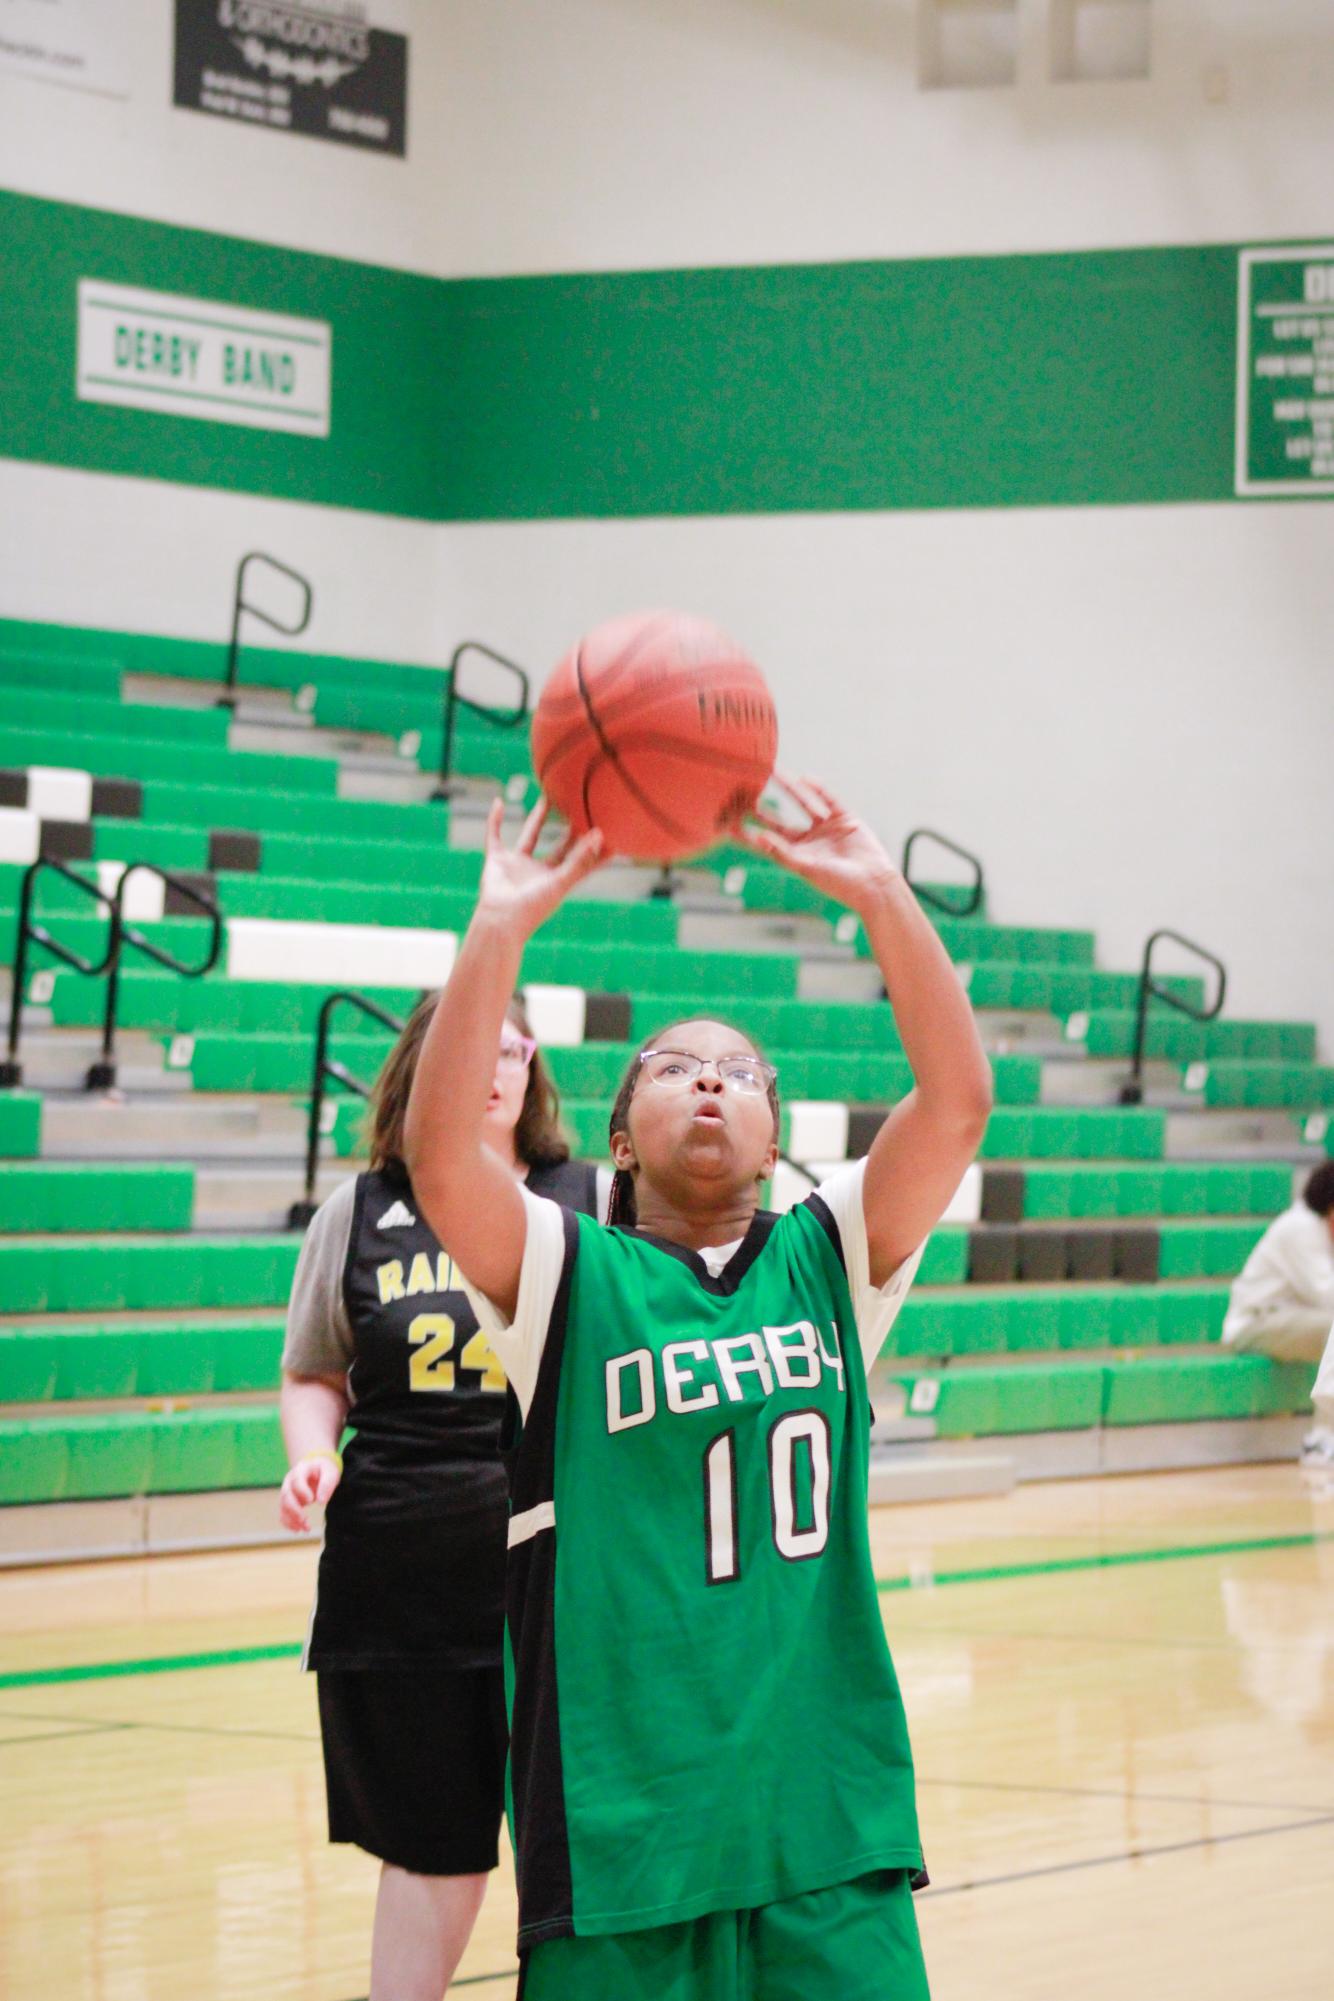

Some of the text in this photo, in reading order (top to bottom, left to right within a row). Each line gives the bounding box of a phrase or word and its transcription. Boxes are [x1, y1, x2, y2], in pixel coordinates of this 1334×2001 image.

[115, 325, 296, 395] DERBY BAND
[407, 1312, 508, 1393] 24
[605, 1319, 845, 1435] DERBY
[704, 1406, 832, 1587] 10
